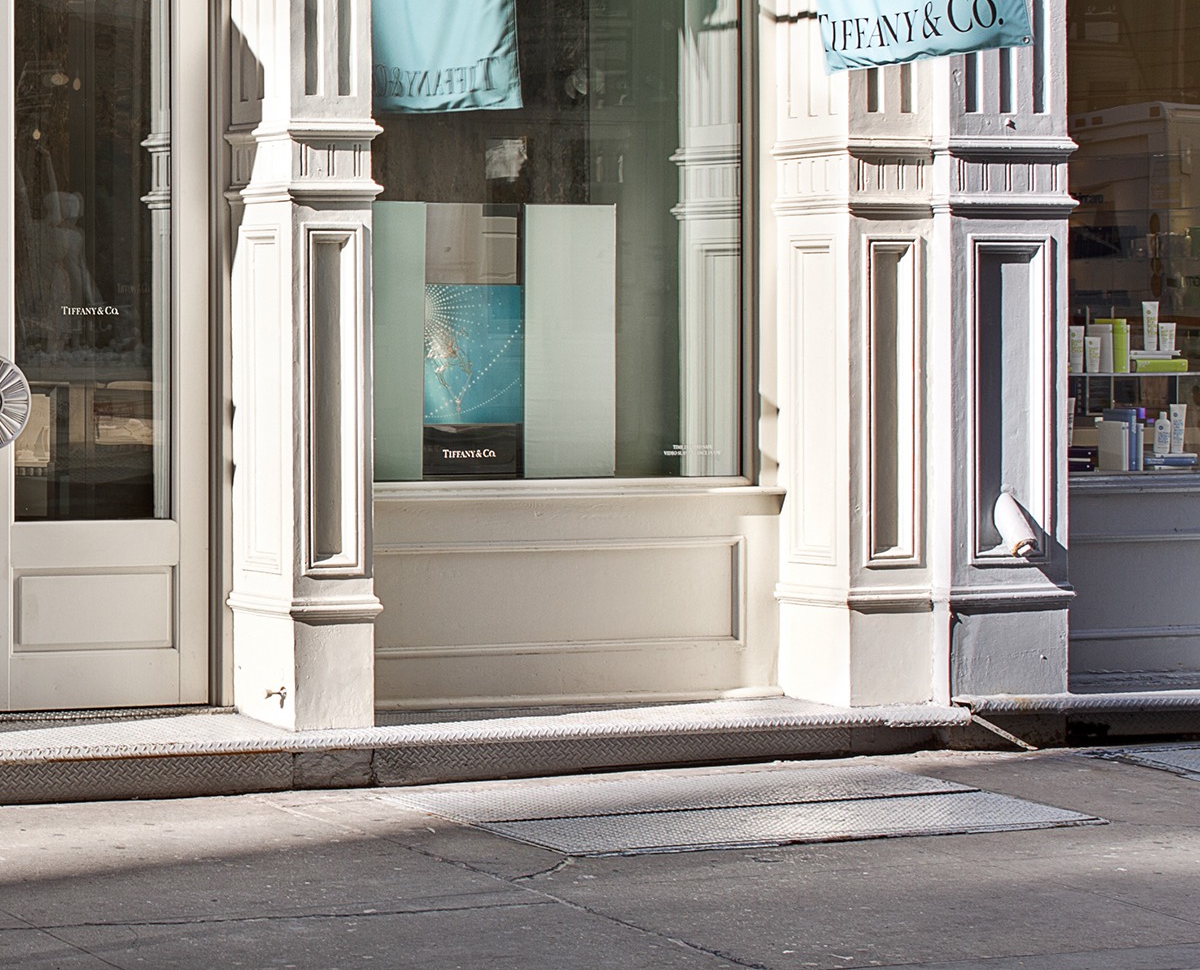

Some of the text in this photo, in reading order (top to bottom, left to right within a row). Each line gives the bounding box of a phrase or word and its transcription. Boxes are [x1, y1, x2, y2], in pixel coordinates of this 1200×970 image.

[922, 1, 943, 39] &
[61, 305, 97, 315] TIFFANY
[442, 449, 476, 459] TIFFANY
